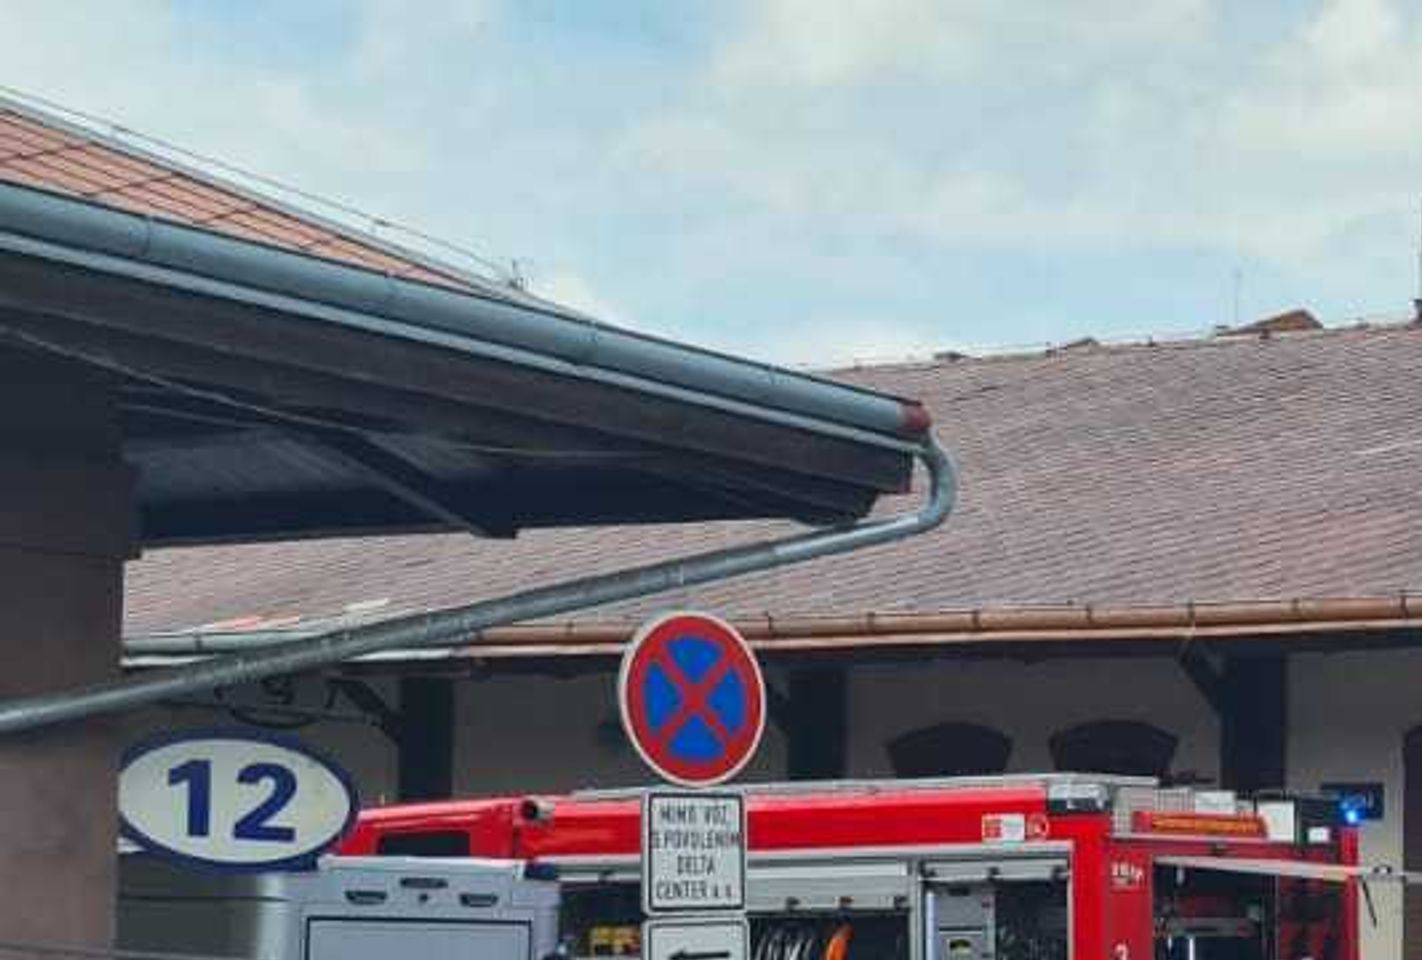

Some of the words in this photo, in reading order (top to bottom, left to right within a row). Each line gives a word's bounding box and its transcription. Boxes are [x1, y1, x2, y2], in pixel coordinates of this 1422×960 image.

[168, 759, 297, 842] 12
[677, 854, 714, 875] DELTA
[656, 880, 708, 899] CENTER
